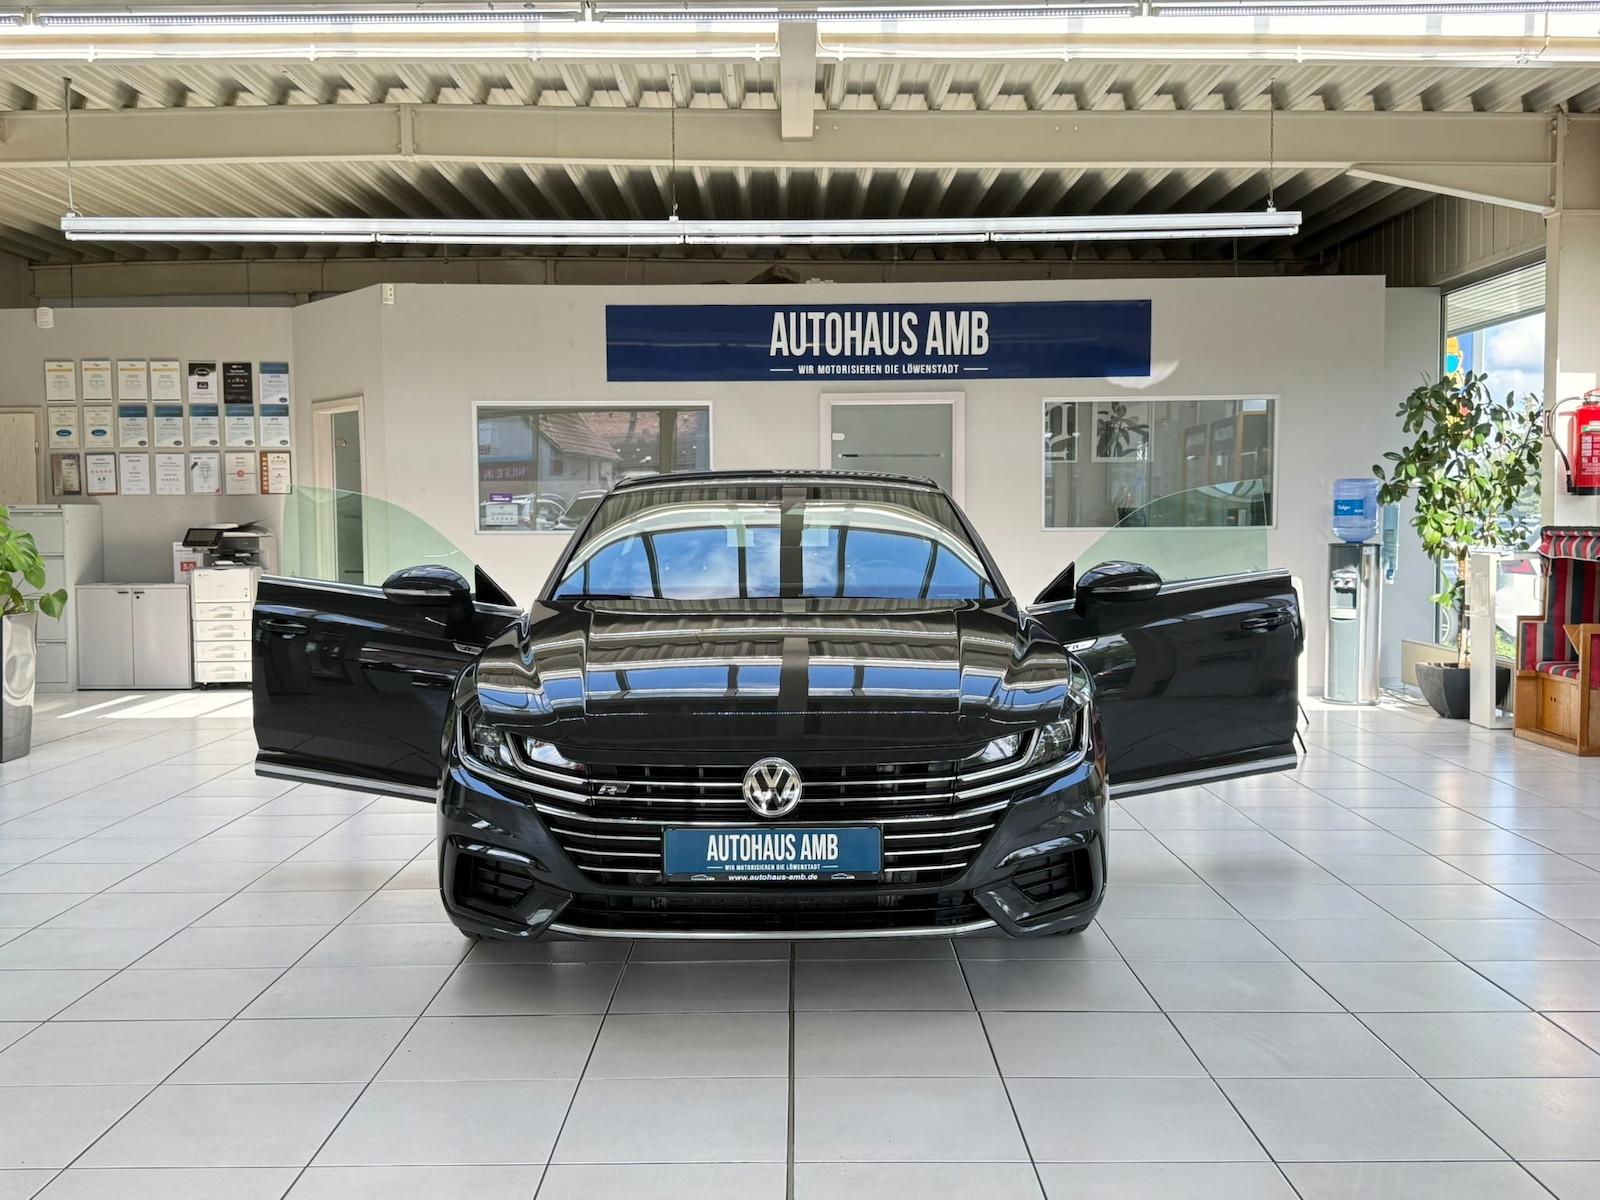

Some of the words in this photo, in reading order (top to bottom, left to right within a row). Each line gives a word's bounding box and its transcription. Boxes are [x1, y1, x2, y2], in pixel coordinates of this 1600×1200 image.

[769, 311, 918, 356] AUTOHAUS
[925, 310, 990, 356] AMB
[798, 365, 814, 375] WIR
[817, 364, 882, 375] MOTORISIEREN
[884, 364, 899, 375] DIE
[902, 362, 960, 374] LÖWENSTADT
[707, 833, 796, 861] AUTOHAUS
[800, 833, 838, 860] AMB
[728, 873, 818, 881] www.autohaus-amb.de
